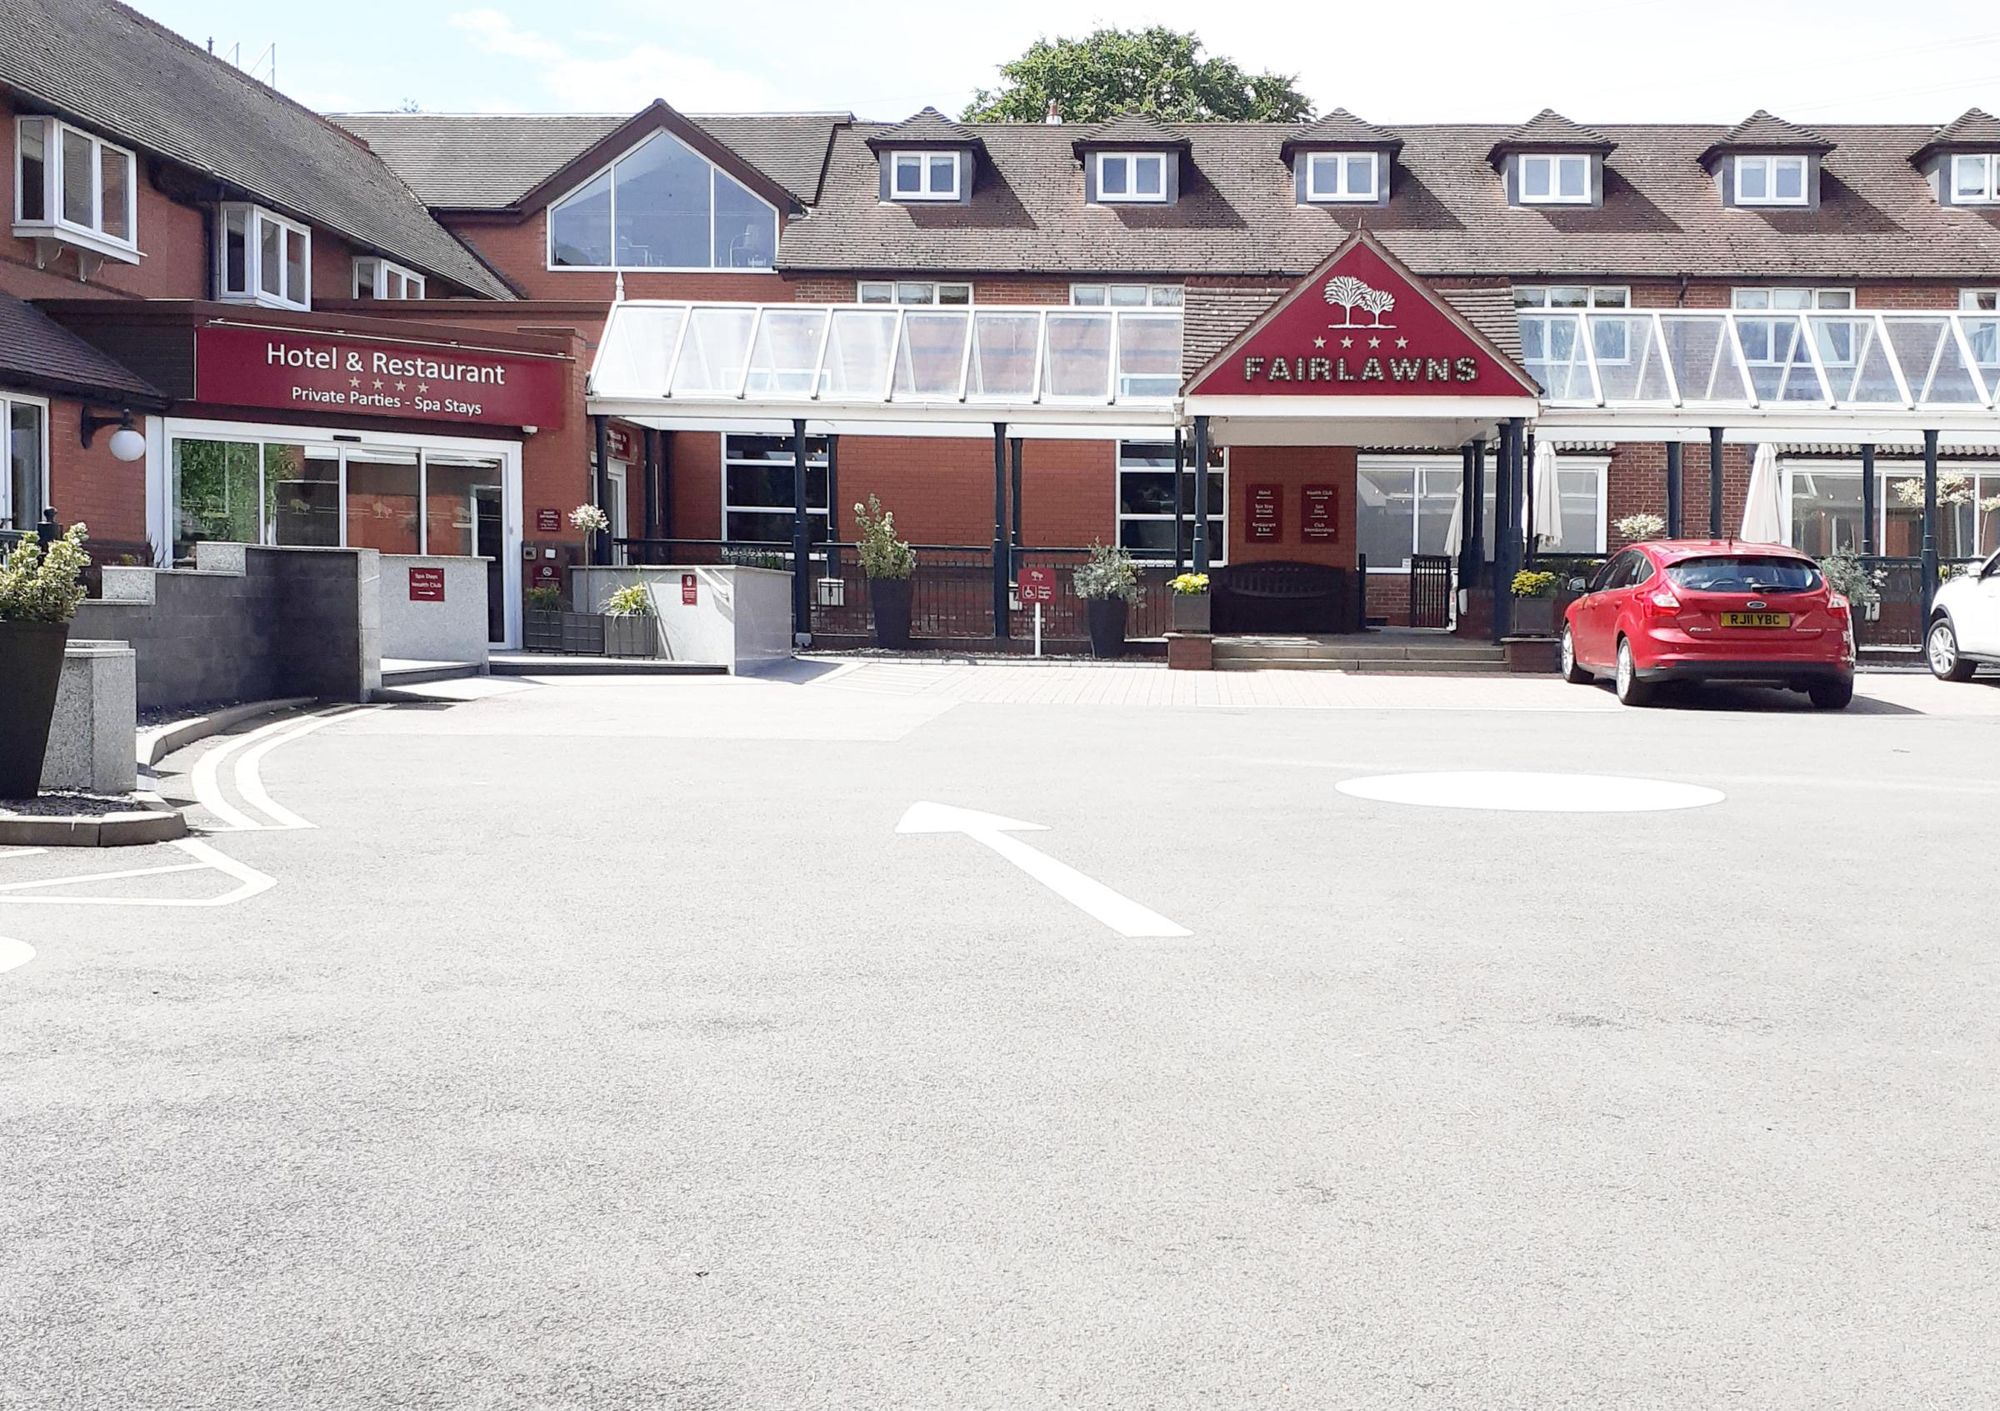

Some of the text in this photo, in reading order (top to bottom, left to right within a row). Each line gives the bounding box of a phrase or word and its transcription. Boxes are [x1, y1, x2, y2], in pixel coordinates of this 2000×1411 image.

[266, 342, 505, 384] Hotel & Restaurant
[1243, 356, 1479, 383] FAIRLAWNS
[292, 387, 345, 404] Private
[350, 391, 401, 408] Parties
[415, 397, 441, 413] Spa
[444, 399, 482, 416] Stays
[1730, 614, 1780, 625] RJ11 YBC
